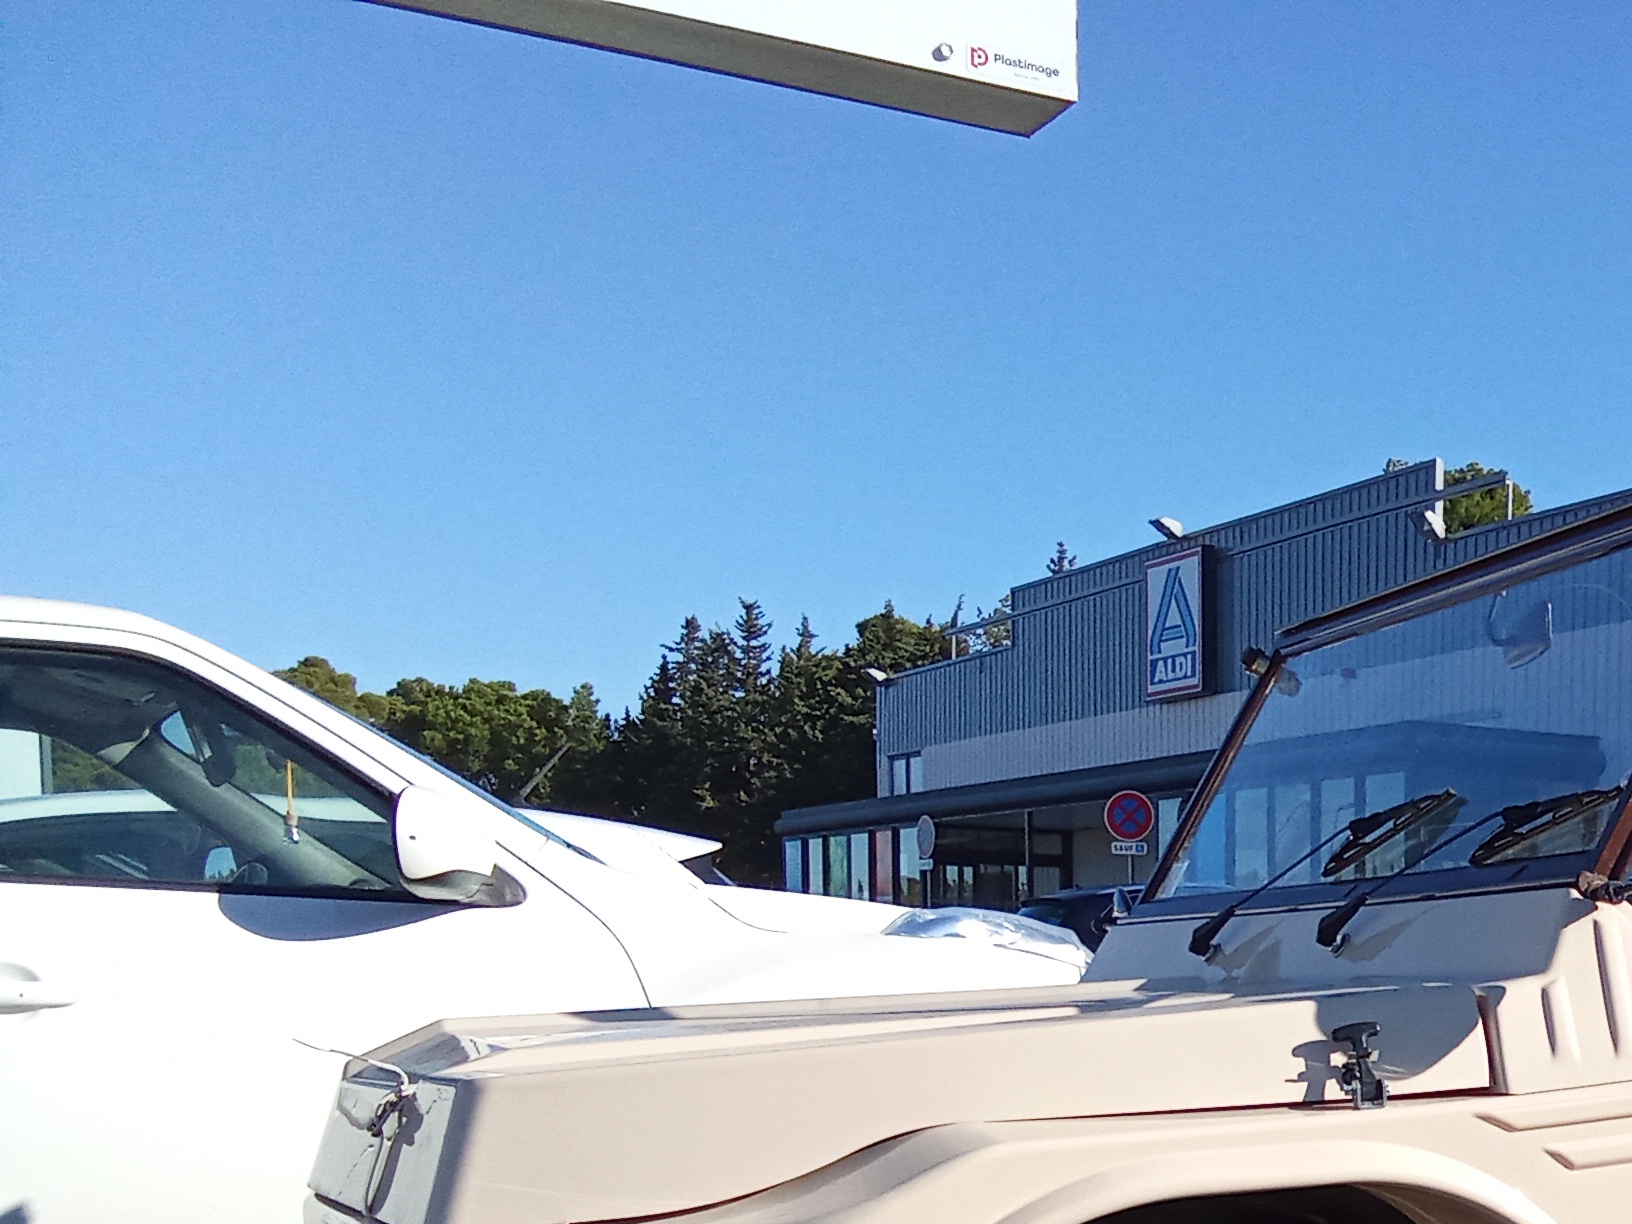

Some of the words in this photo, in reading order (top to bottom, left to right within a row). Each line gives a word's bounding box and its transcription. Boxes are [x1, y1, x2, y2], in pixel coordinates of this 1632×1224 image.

[993, 53, 1060, 77] Plastimage
[1154, 655, 1193, 683] ALDI
[1113, 844, 1134, 852] SAUF
